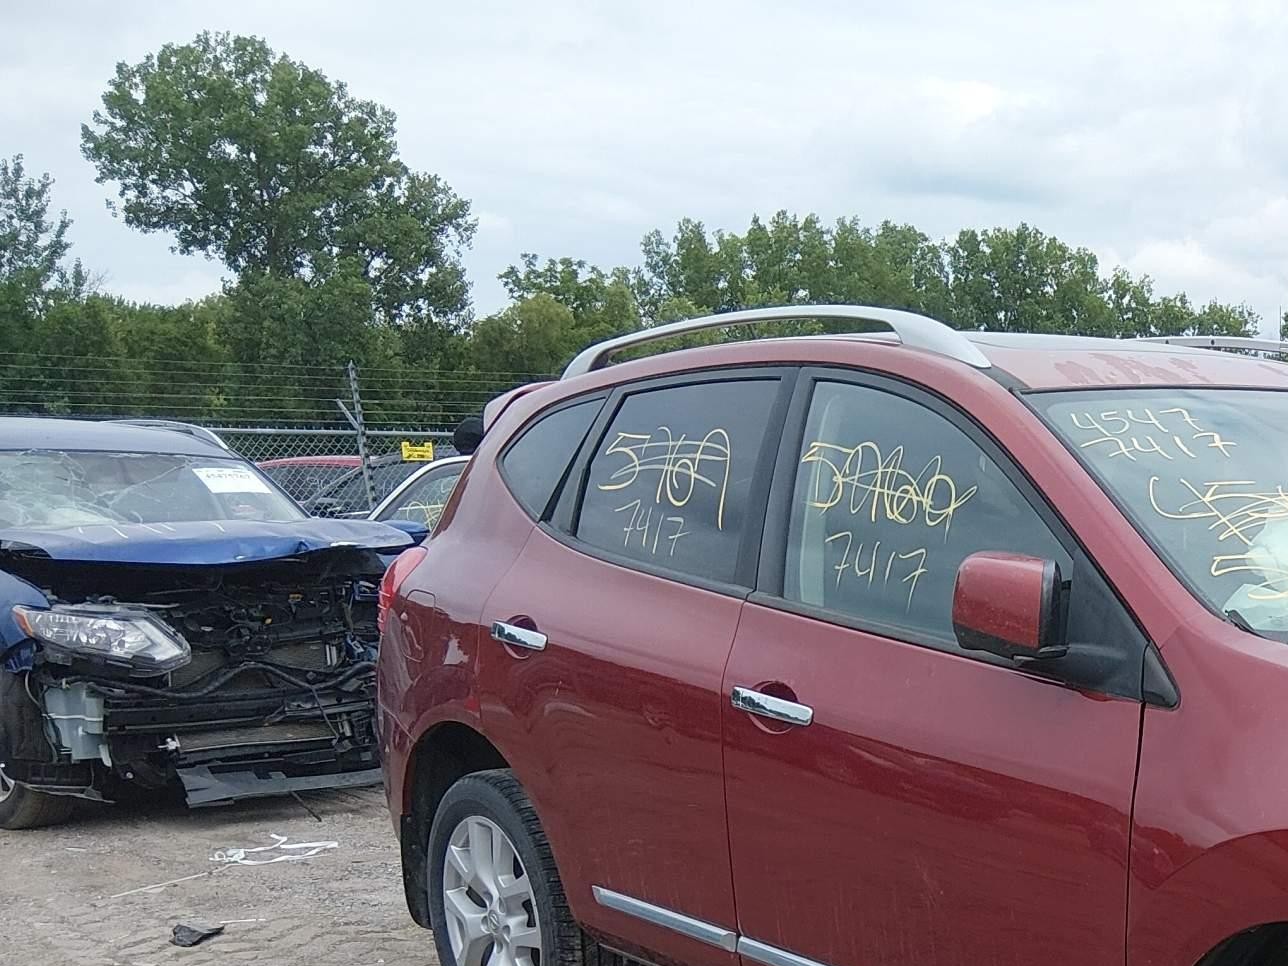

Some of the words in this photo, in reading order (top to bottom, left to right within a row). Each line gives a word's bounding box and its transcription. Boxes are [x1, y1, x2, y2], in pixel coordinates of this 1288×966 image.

[1070, 408, 1204, 437] 4547
[1079, 432, 1237, 462] 7417
[614, 498, 694, 557] 7417
[824, 531, 929, 615] 7417
